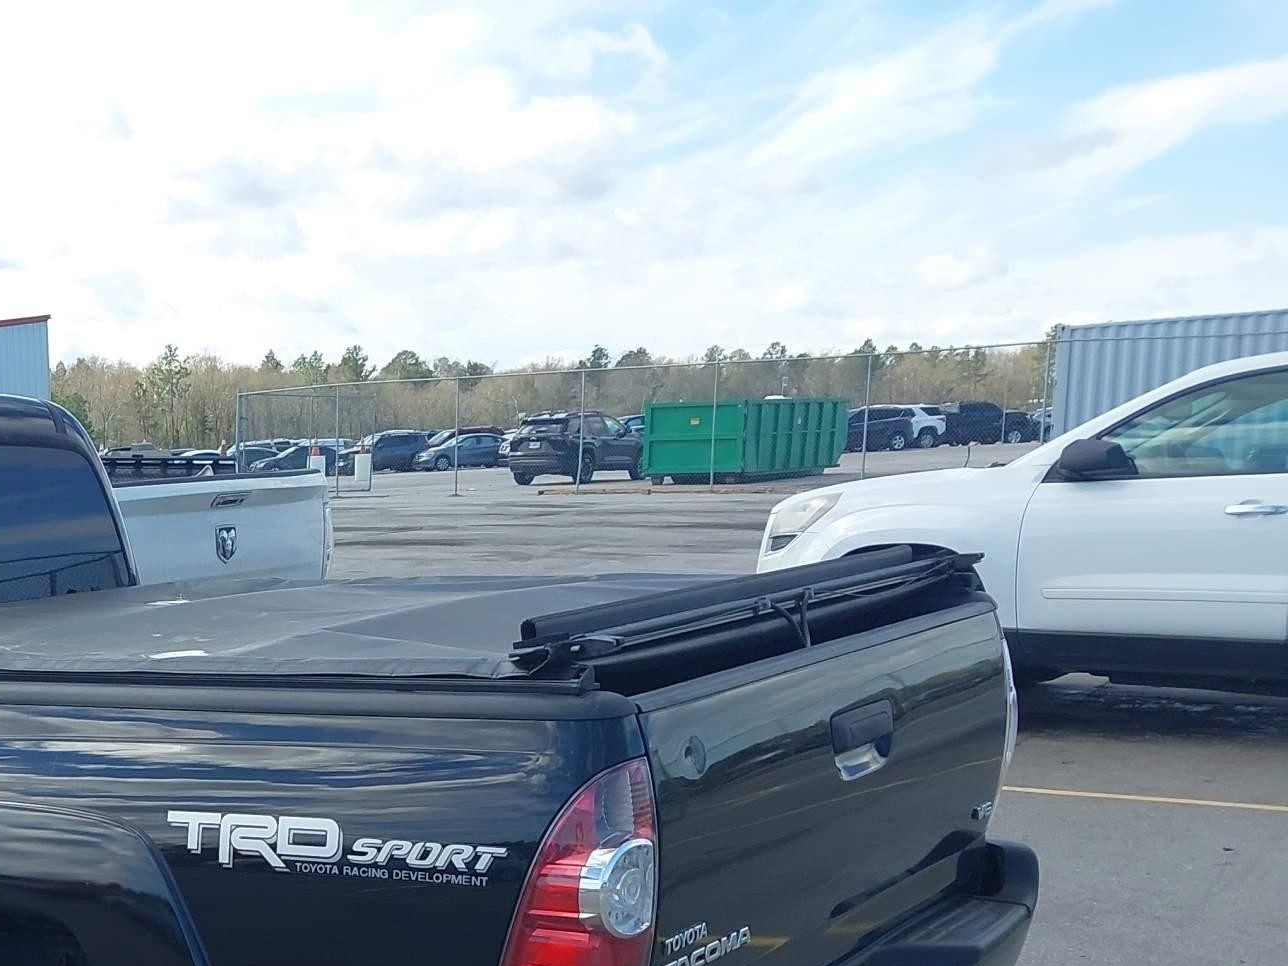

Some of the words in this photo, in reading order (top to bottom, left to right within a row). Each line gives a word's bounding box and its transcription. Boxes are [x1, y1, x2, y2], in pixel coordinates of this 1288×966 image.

[167, 810, 344, 872] TRD
[347, 838, 507, 873] SPORT
[295, 861, 340, 877] TOYOTA
[343, 865, 389, 880] RACING
[392, 869, 489, 888] DEVELOPMENT
[665, 921, 708, 955] TOYOTA
